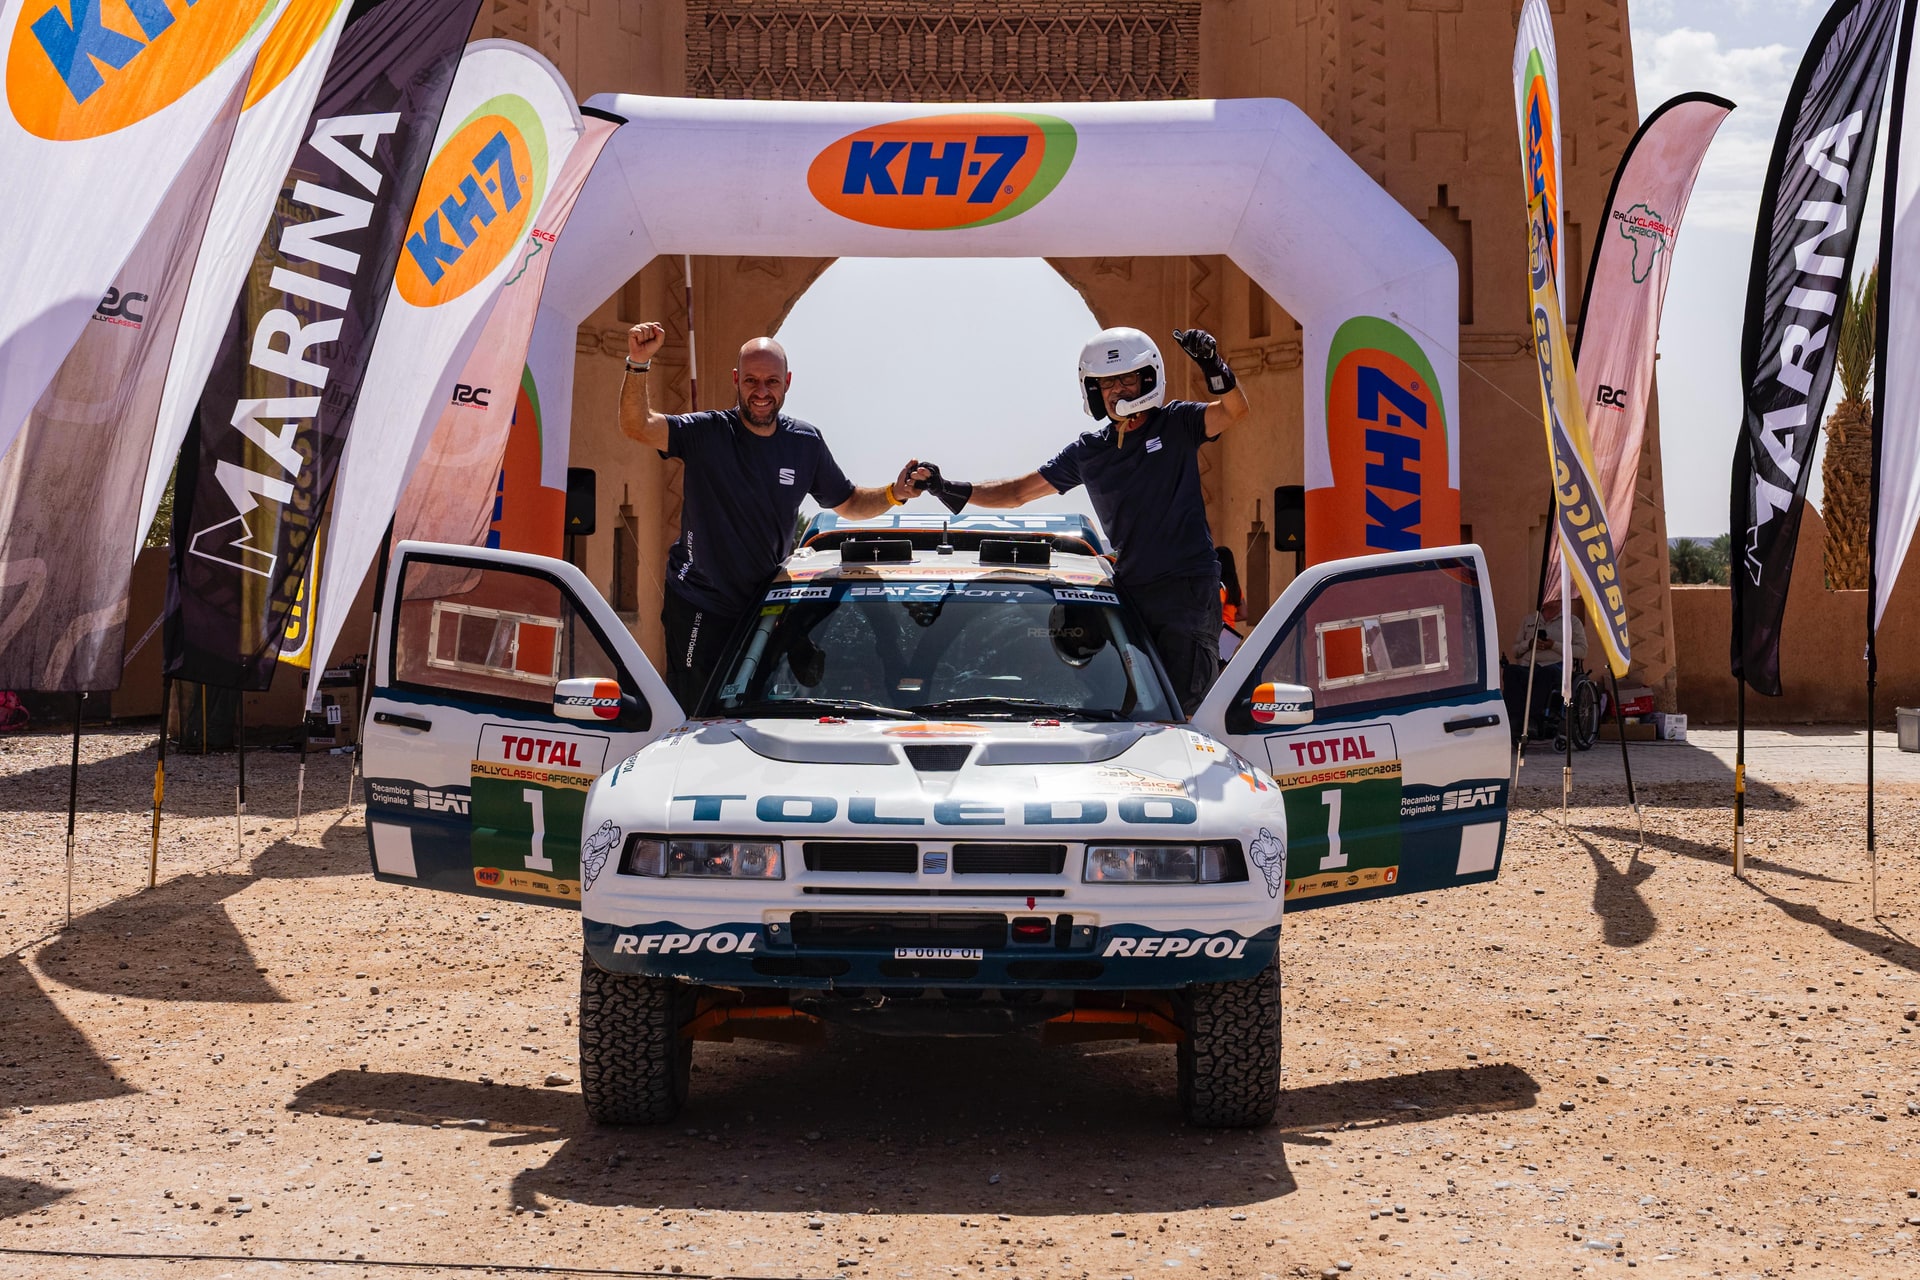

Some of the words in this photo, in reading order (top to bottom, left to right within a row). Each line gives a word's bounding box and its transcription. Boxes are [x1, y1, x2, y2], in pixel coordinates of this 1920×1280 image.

[842, 136, 1028, 203] KH-7
[405, 130, 522, 286] KH-7
[1628, 225, 1657, 239] AFRICA
[189, 112, 400, 577] MARINA
[1744, 109, 1863, 587] MARINA
[771, 588, 829, 599] Trident
[850, 586, 910, 597] SEAT
[1056, 590, 1116, 603] Trident
[1027, 627, 1084, 638] RECARO
[564, 695, 620, 707] REPSOL
[1252, 702, 1302, 712] REPSOL
[501, 735, 581, 768] TOTAL
[1289, 735, 1376, 767] TOTAL
[371, 783, 411, 796] Recambios
[372, 793, 408, 806] Originales
[1401, 794, 1440, 806] Recambios
[1441, 785, 1501, 811] SEAT
[413, 788, 472, 815] SEAT
[673, 795, 1197, 825] TOLEDO
[1400, 805, 1436, 816] Originales
[523, 788, 553, 872] 1
[1319, 788, 1349, 871] 1
[613, 932, 757, 955] REPSOL
[1102, 936, 1249, 959] REPSOL
